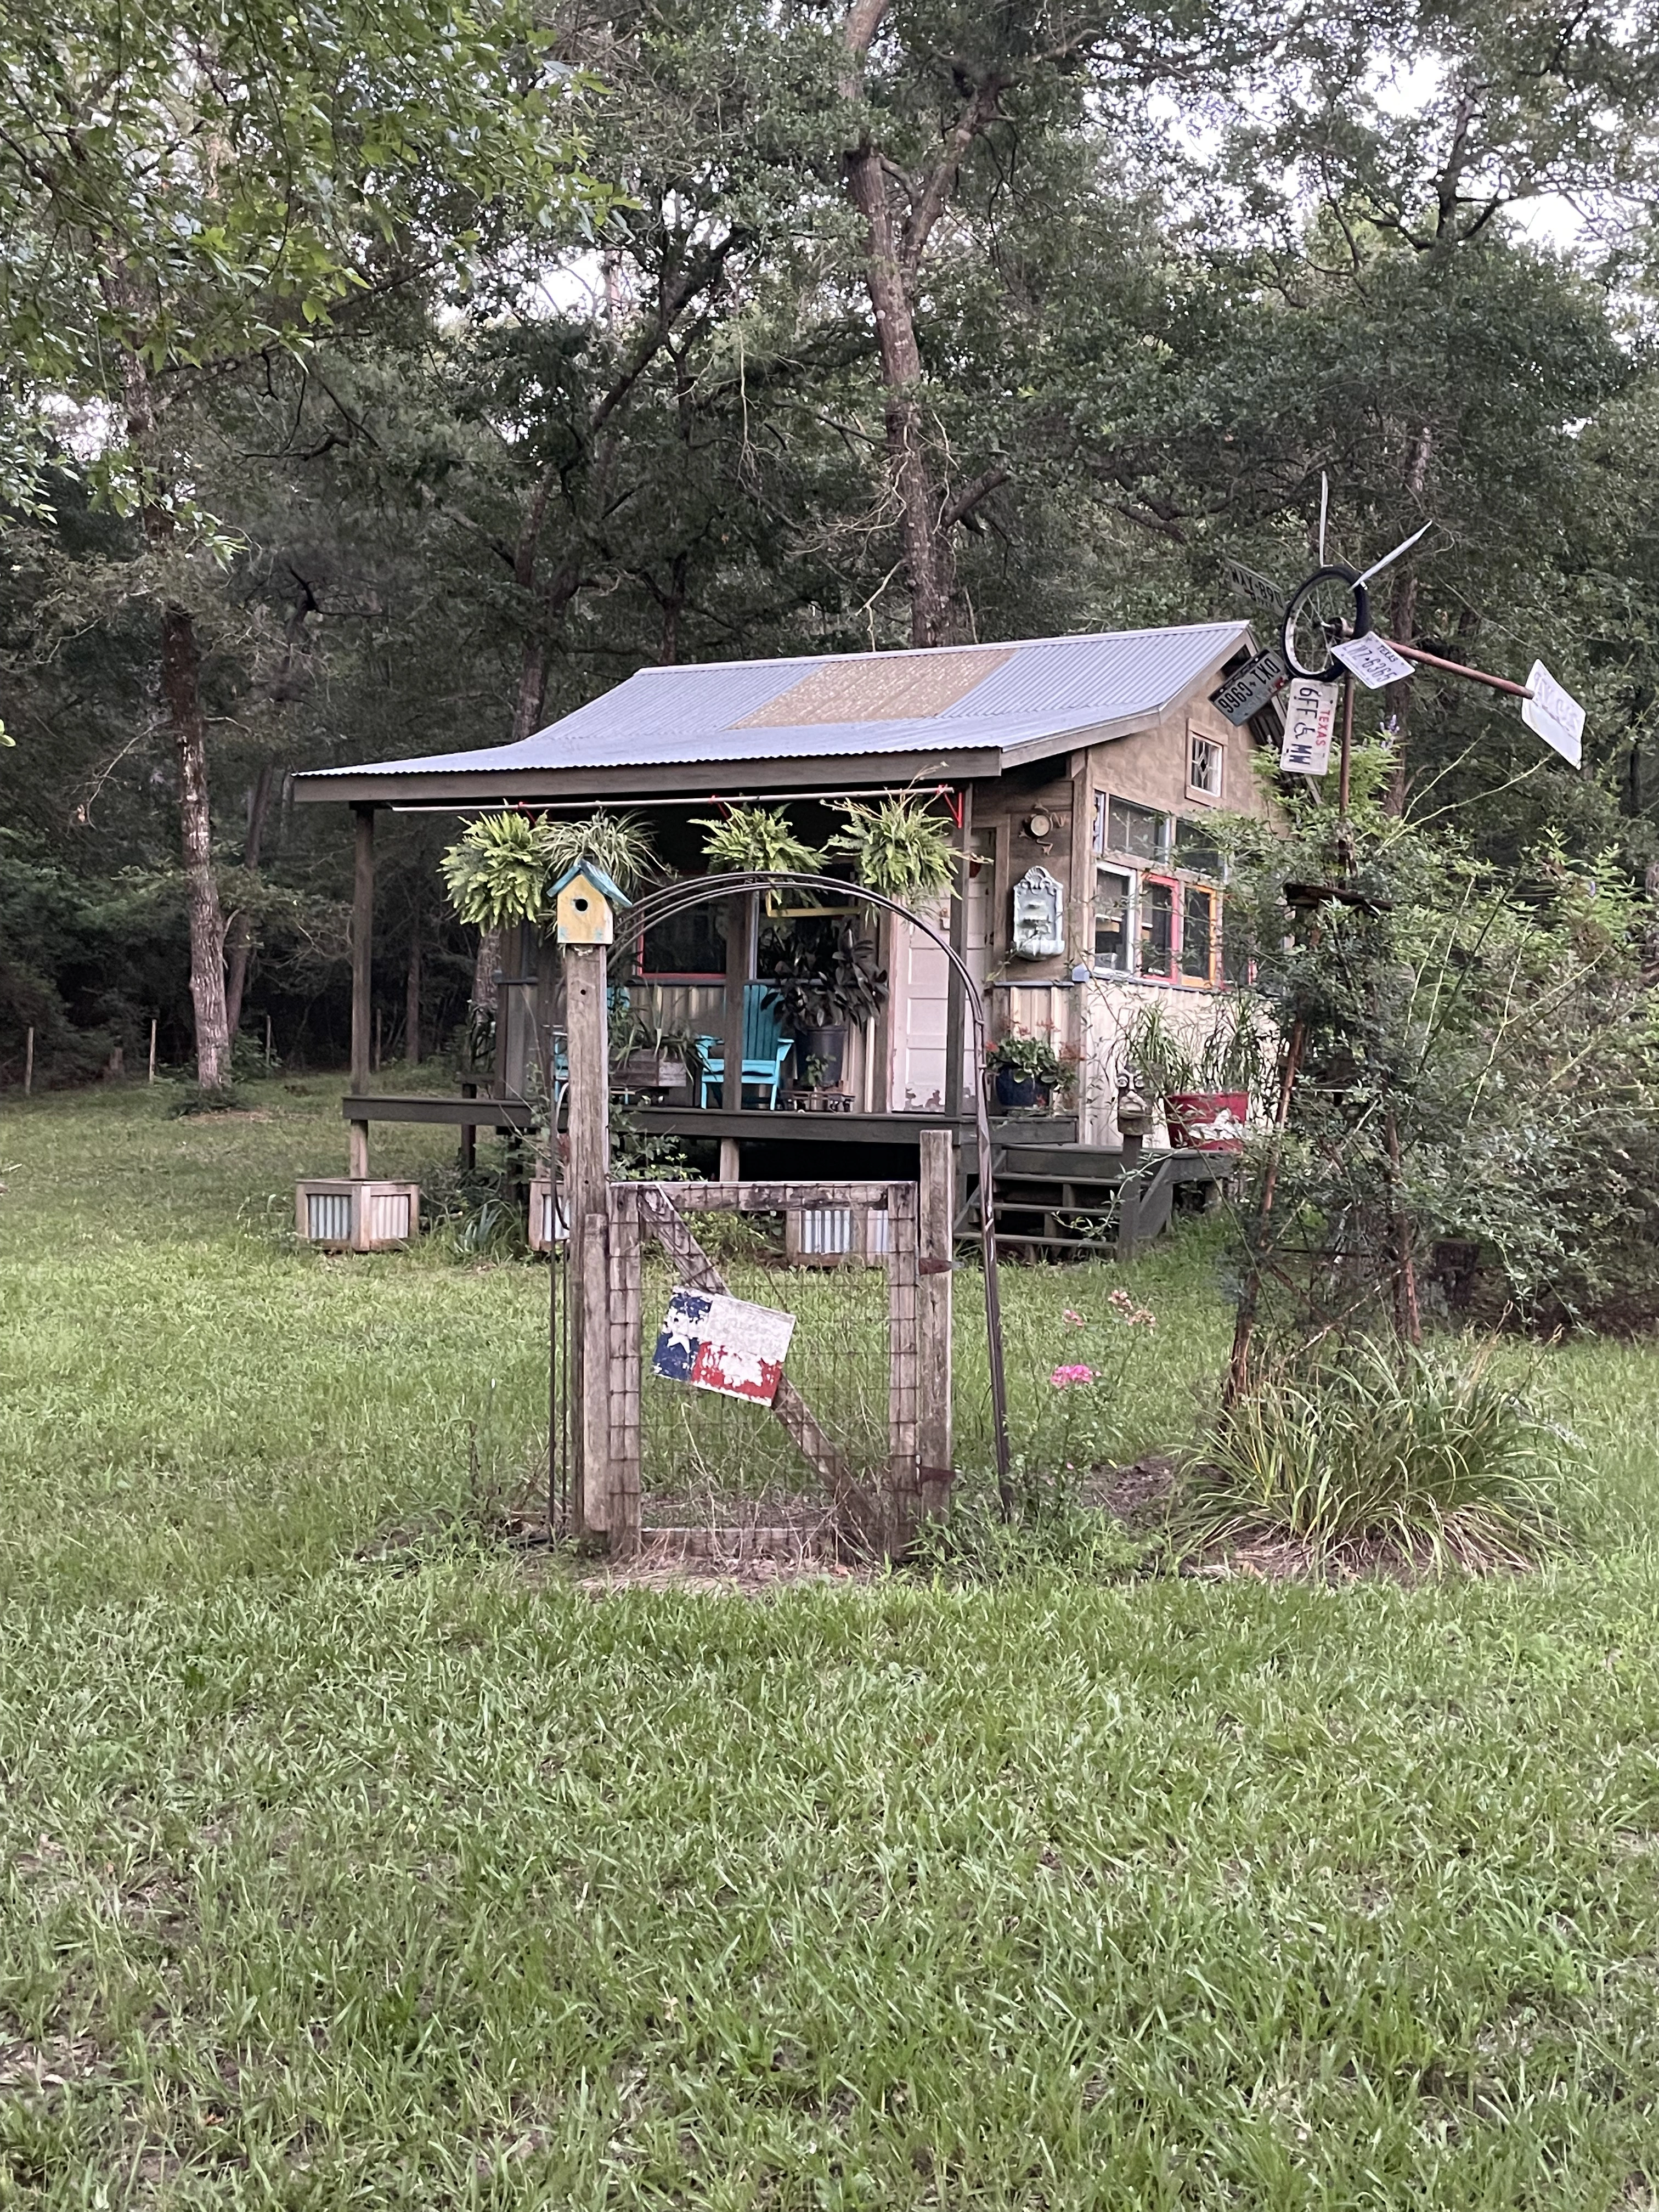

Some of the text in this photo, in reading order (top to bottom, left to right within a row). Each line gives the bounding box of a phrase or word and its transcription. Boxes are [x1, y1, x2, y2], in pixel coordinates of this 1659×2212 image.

[1377, 644, 1399, 663] TEXAS
[1217, 657, 1281, 715] DX1 G966
[1362, 659, 1398, 682] 6365
[1296, 687, 1321, 719] 6FF
[1315, 709, 1330, 747] TEXAS
